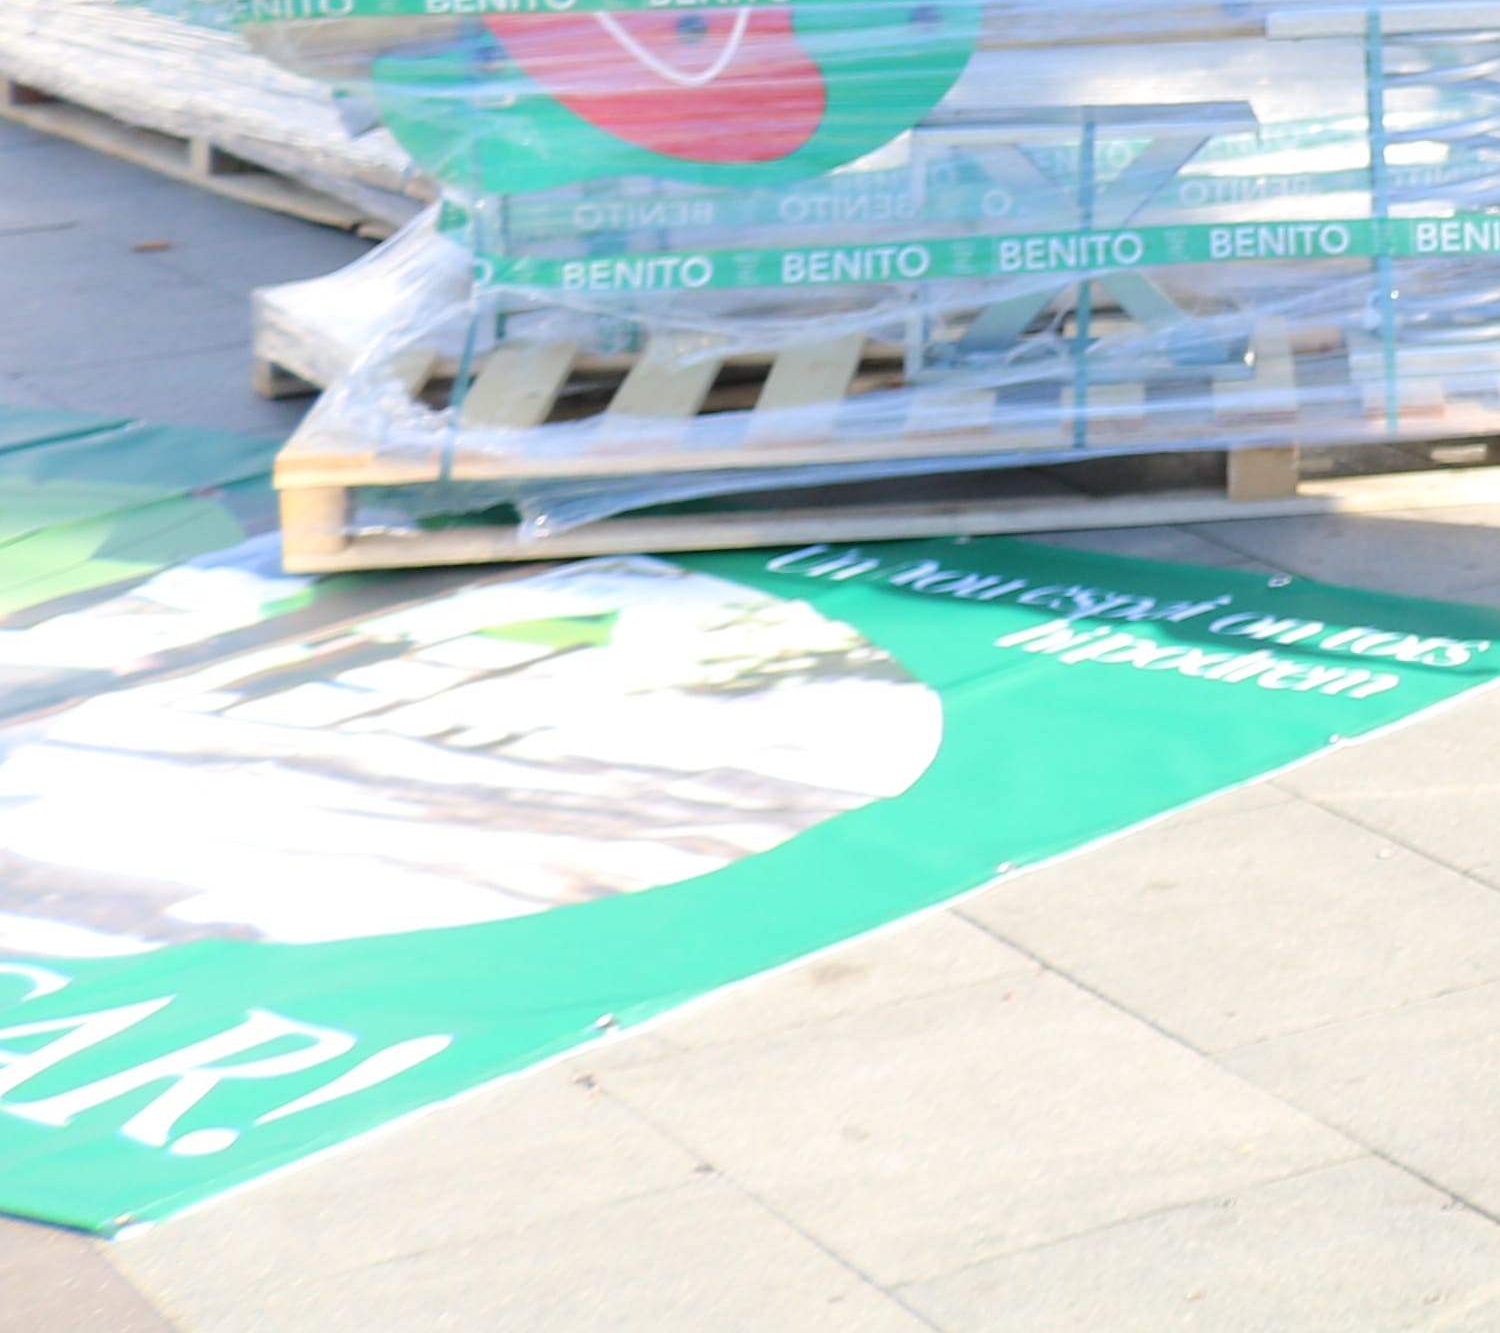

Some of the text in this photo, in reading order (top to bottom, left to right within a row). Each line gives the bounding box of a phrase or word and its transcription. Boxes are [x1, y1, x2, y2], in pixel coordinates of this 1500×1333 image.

[562, 255, 713, 291] BENITO
[782, 245, 930, 283] BENITO
[1000, 233, 1145, 271] BENITO
[1209, 223, 1350, 259] BENITO
